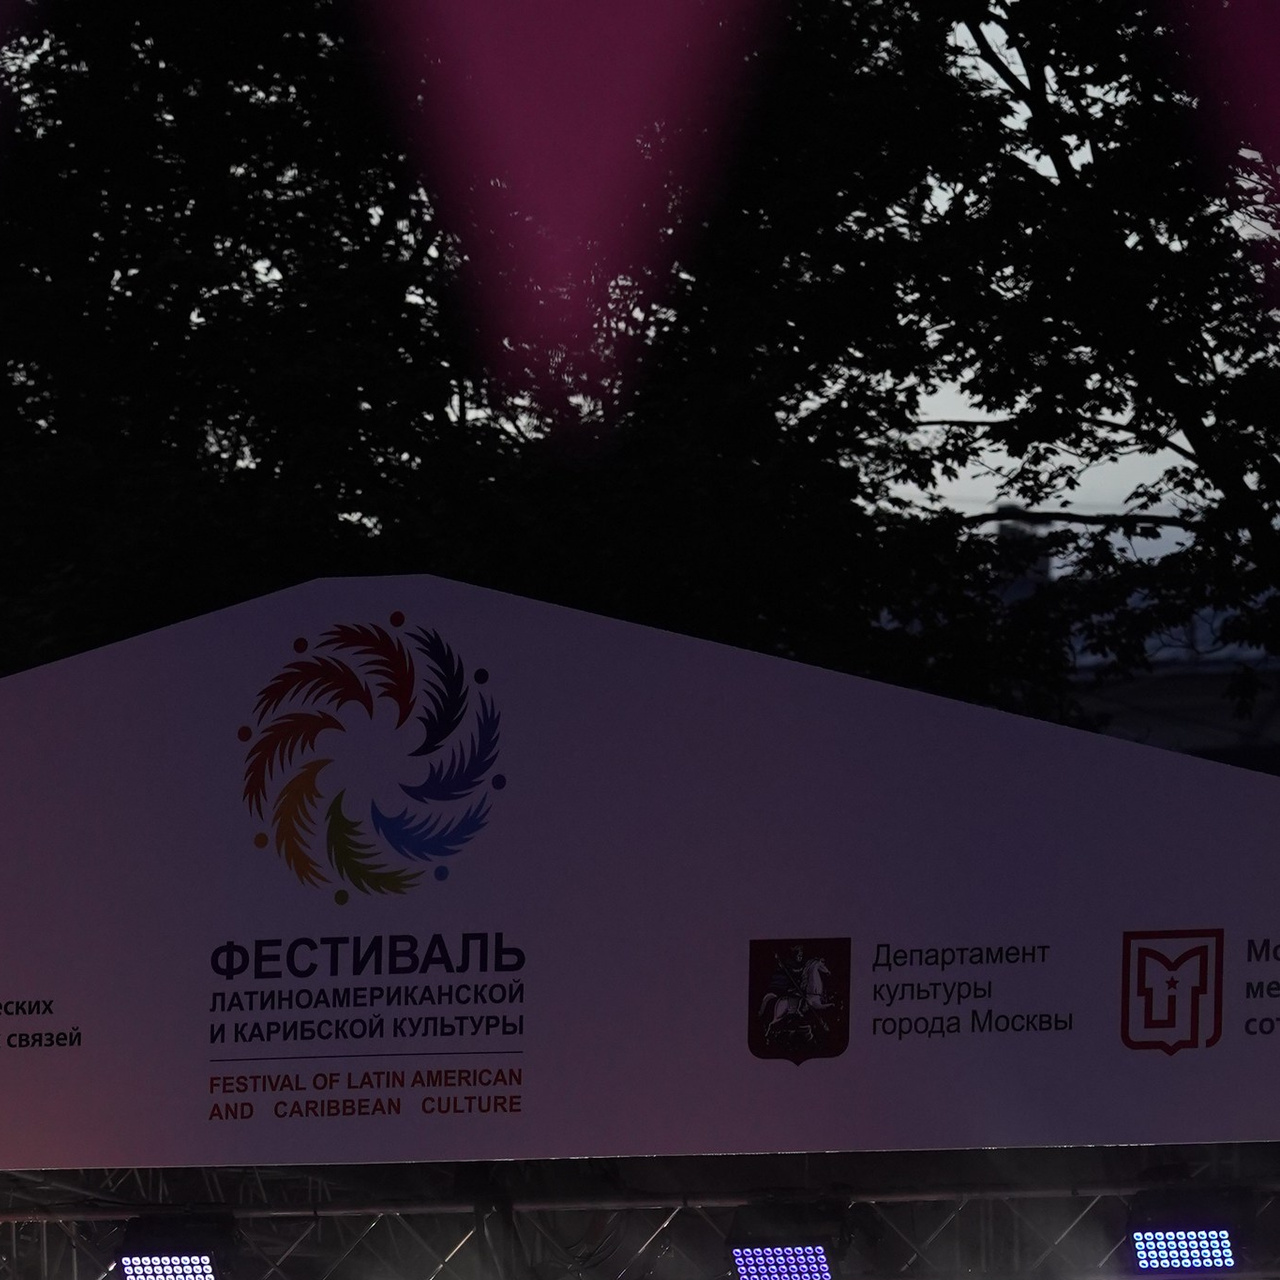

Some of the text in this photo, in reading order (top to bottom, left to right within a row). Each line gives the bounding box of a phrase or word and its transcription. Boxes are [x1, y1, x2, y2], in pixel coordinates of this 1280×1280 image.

[210, 932, 526, 980] ФЕСТИВАЛЬ
[872, 944, 1050, 971] Департамент
[209, 979, 524, 1012] ЛАТИНОАМЕРИКАНСКОЙ
[873, 981, 992, 1006] культуры
[7, 1027, 82, 1048] связей
[209, 1014, 524, 1043] И КАРИБСКОЙ КУЛЬТУРЫ
[872, 1010, 1073, 1040] города Москвы
[209, 1068, 522, 1094] FESTIVAL OF LATIN AMERICAN
[209, 1095, 522, 1120] AND CARIBBEAN CULTURE
